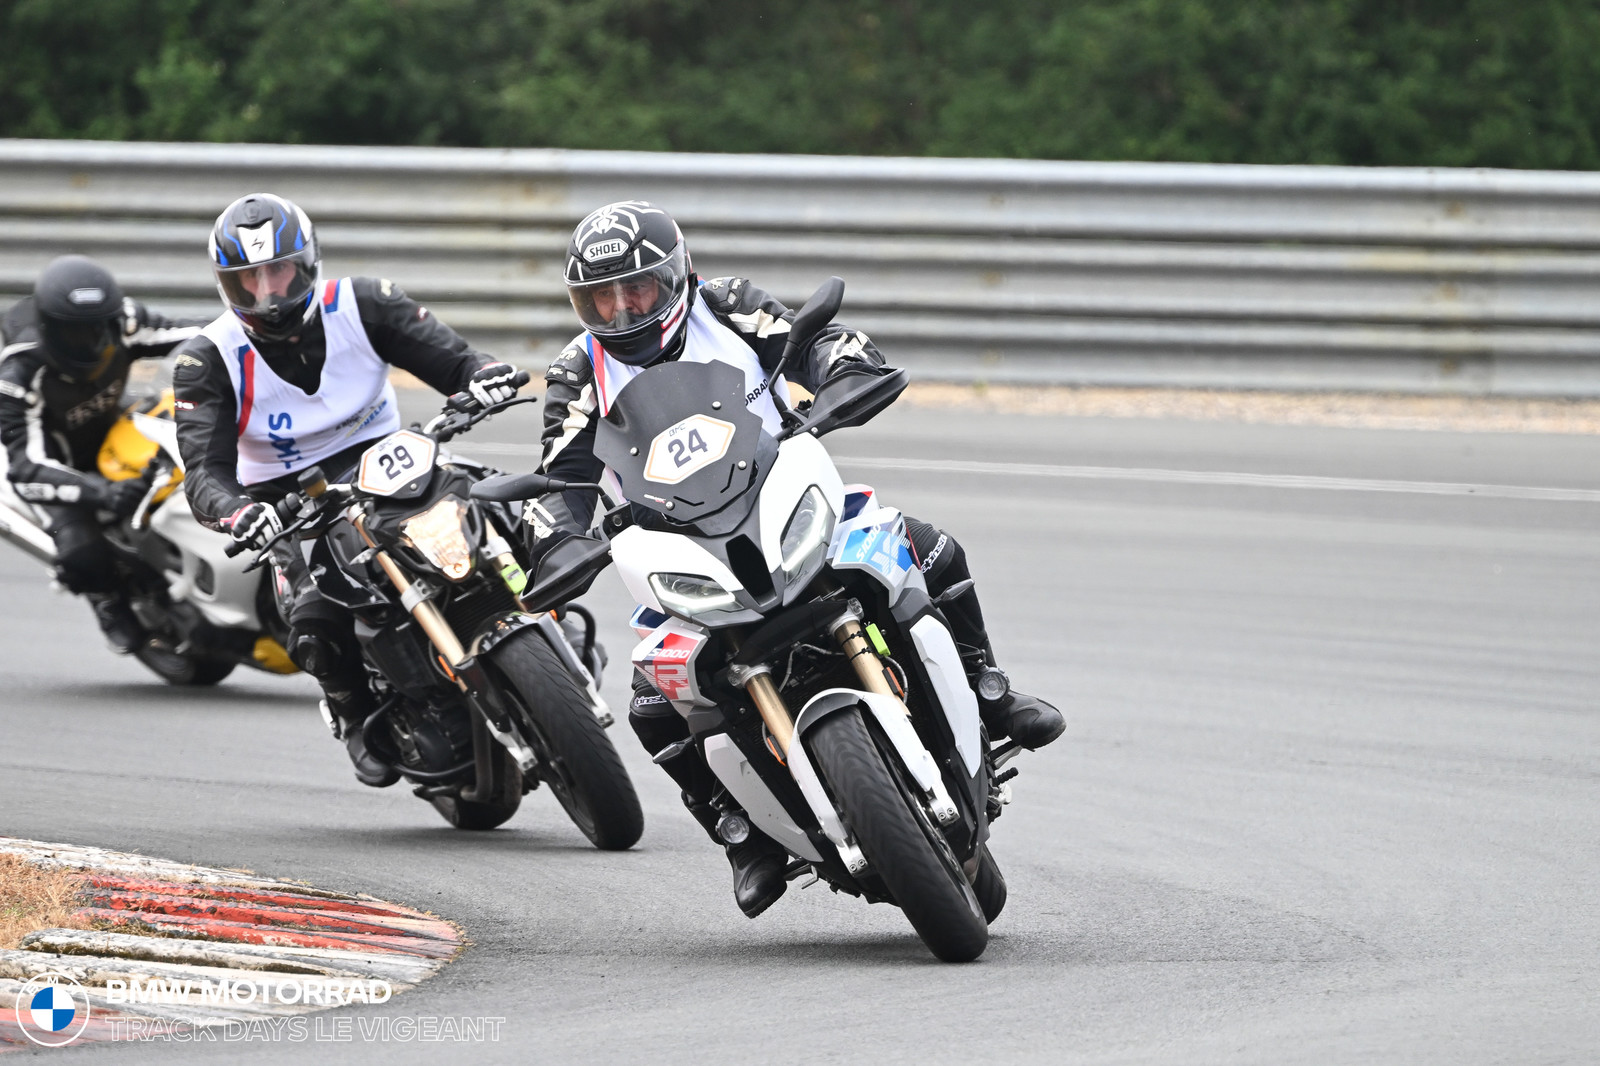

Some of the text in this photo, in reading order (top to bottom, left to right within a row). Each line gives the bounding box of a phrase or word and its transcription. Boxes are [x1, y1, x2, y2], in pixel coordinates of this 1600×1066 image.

[589, 242, 621, 258] SHOEI
[667, 428, 708, 468] 24
[378, 445, 415, 480] 29
[648, 648, 691, 659] S1000
